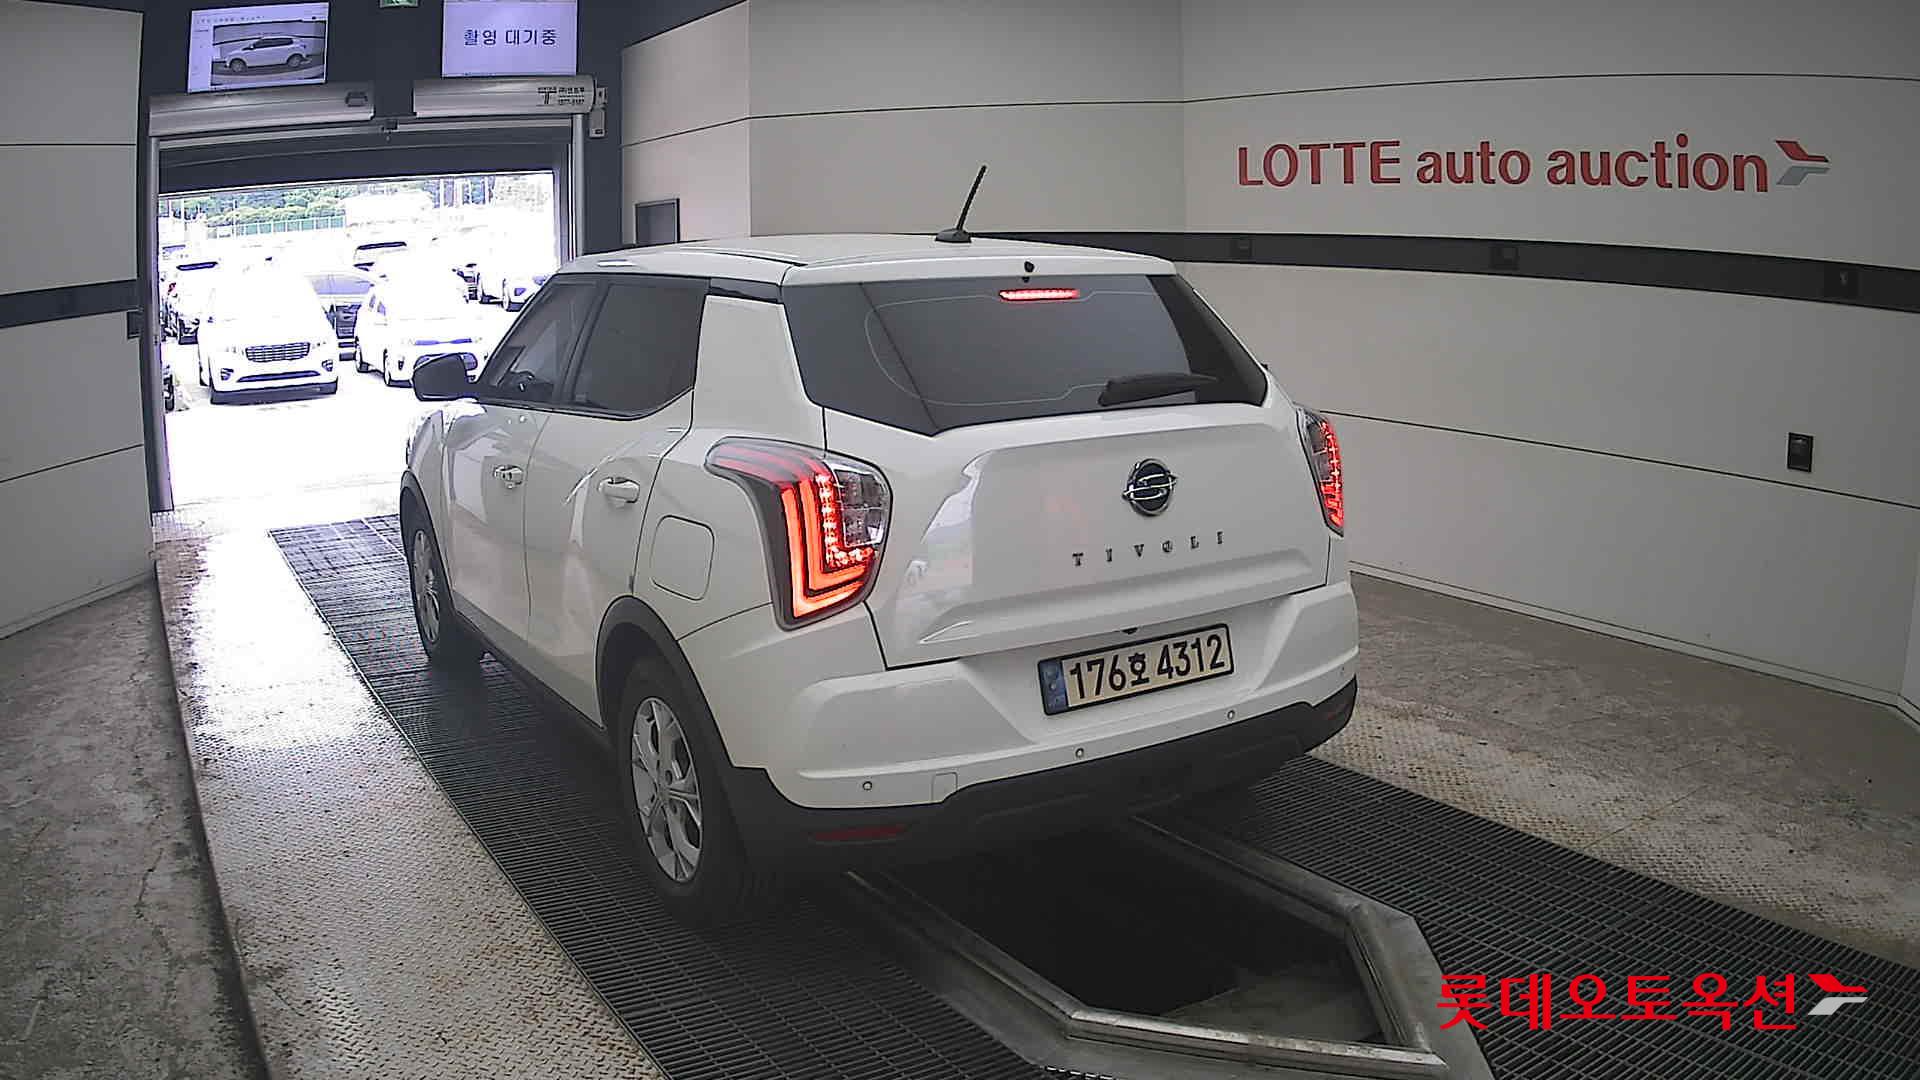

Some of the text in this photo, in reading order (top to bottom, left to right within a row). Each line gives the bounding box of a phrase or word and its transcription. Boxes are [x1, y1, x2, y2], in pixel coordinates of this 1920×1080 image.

[464, 28, 498, 46] 촬영
[1237, 132, 1769, 193] LOTTE auto auction
[1071, 530, 1224, 567] TIVOLI
[1068, 633, 1226, 700] 176호 4312
